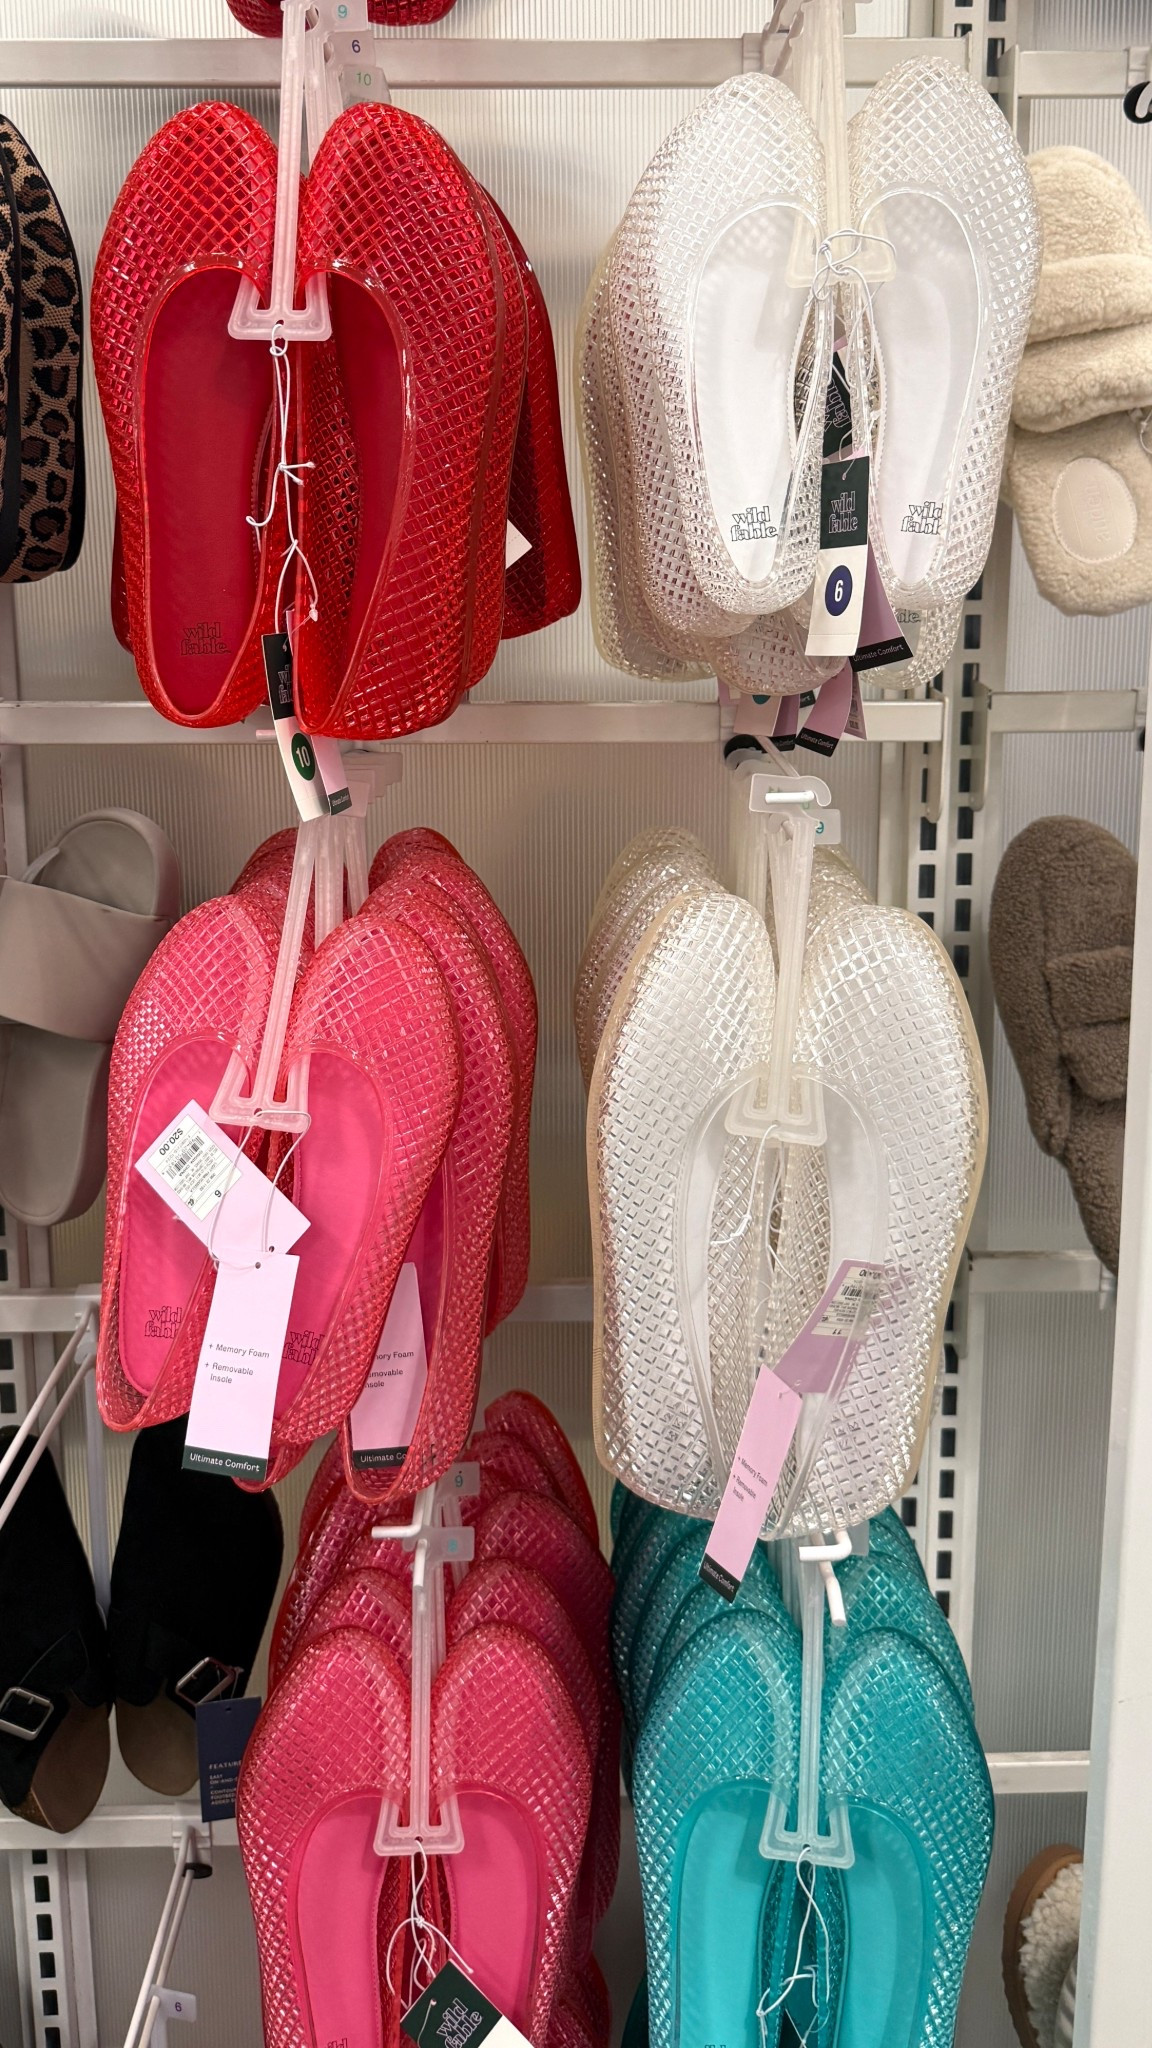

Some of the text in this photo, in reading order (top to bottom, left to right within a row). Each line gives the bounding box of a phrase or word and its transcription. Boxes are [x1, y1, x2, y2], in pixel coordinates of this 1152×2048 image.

[337, 4, 348, 19] 9
[351, 39, 362, 54] 6
[356, 72, 372, 87] 10
[831, 491, 856, 512] wild
[732, 505, 771, 523] wild
[828, 511, 858, 533] fable
[730, 523, 779, 541] fable
[900, 515, 942, 535] fabl
[833, 579, 844, 602] 6
[182, 621, 222, 639] wild
[180, 637, 232, 656] fable
[877, 644, 904, 656] Comfort
[295, 745, 312, 768] 10
[158, 1127, 184, 1156] $20.00
[214, 1189, 222, 1198] 6
[148, 1305, 182, 1324] wild
[144, 1320, 178, 1339] fabl
[215, 1343, 270, 1359] Memory Foam
[282, 1342, 317, 1366] fabl
[393, 1351, 414, 1359] Foam
[212, 1362, 254, 1376] Removable
[209, 1373, 233, 1384] Insole
[364, 1380, 385, 1389] nsole
[189, 1452, 260, 1473] Ultimate Comfort
[360, 1453, 394, 1463] Ultimate
[741, 1458, 768, 1487] Memory Foam
[736, 1475, 757, 1500] Removable
[719, 1574, 735, 1592] Comfort
[174, 2000, 182, 2012] 6
[436, 1997, 469, 2037] wild
